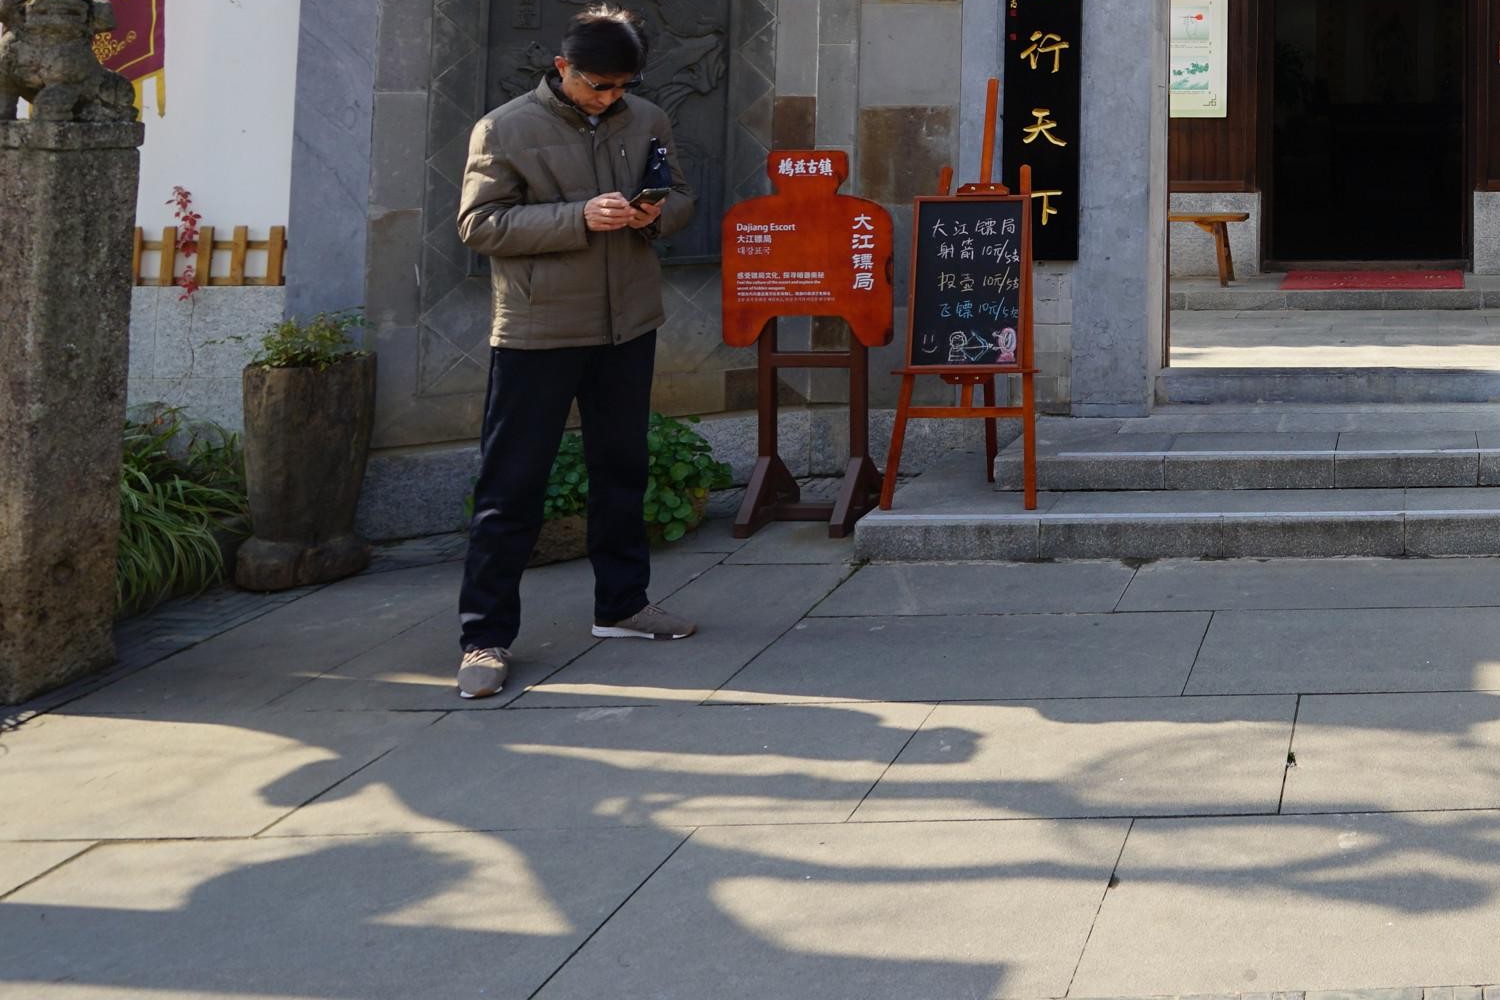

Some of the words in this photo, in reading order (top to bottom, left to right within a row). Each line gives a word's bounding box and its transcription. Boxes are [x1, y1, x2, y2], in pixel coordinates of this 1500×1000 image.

[736, 223, 769, 232] Dajiang
[770, 223, 796, 231] Escort
[852, 213, 875, 290] 大江镖局
